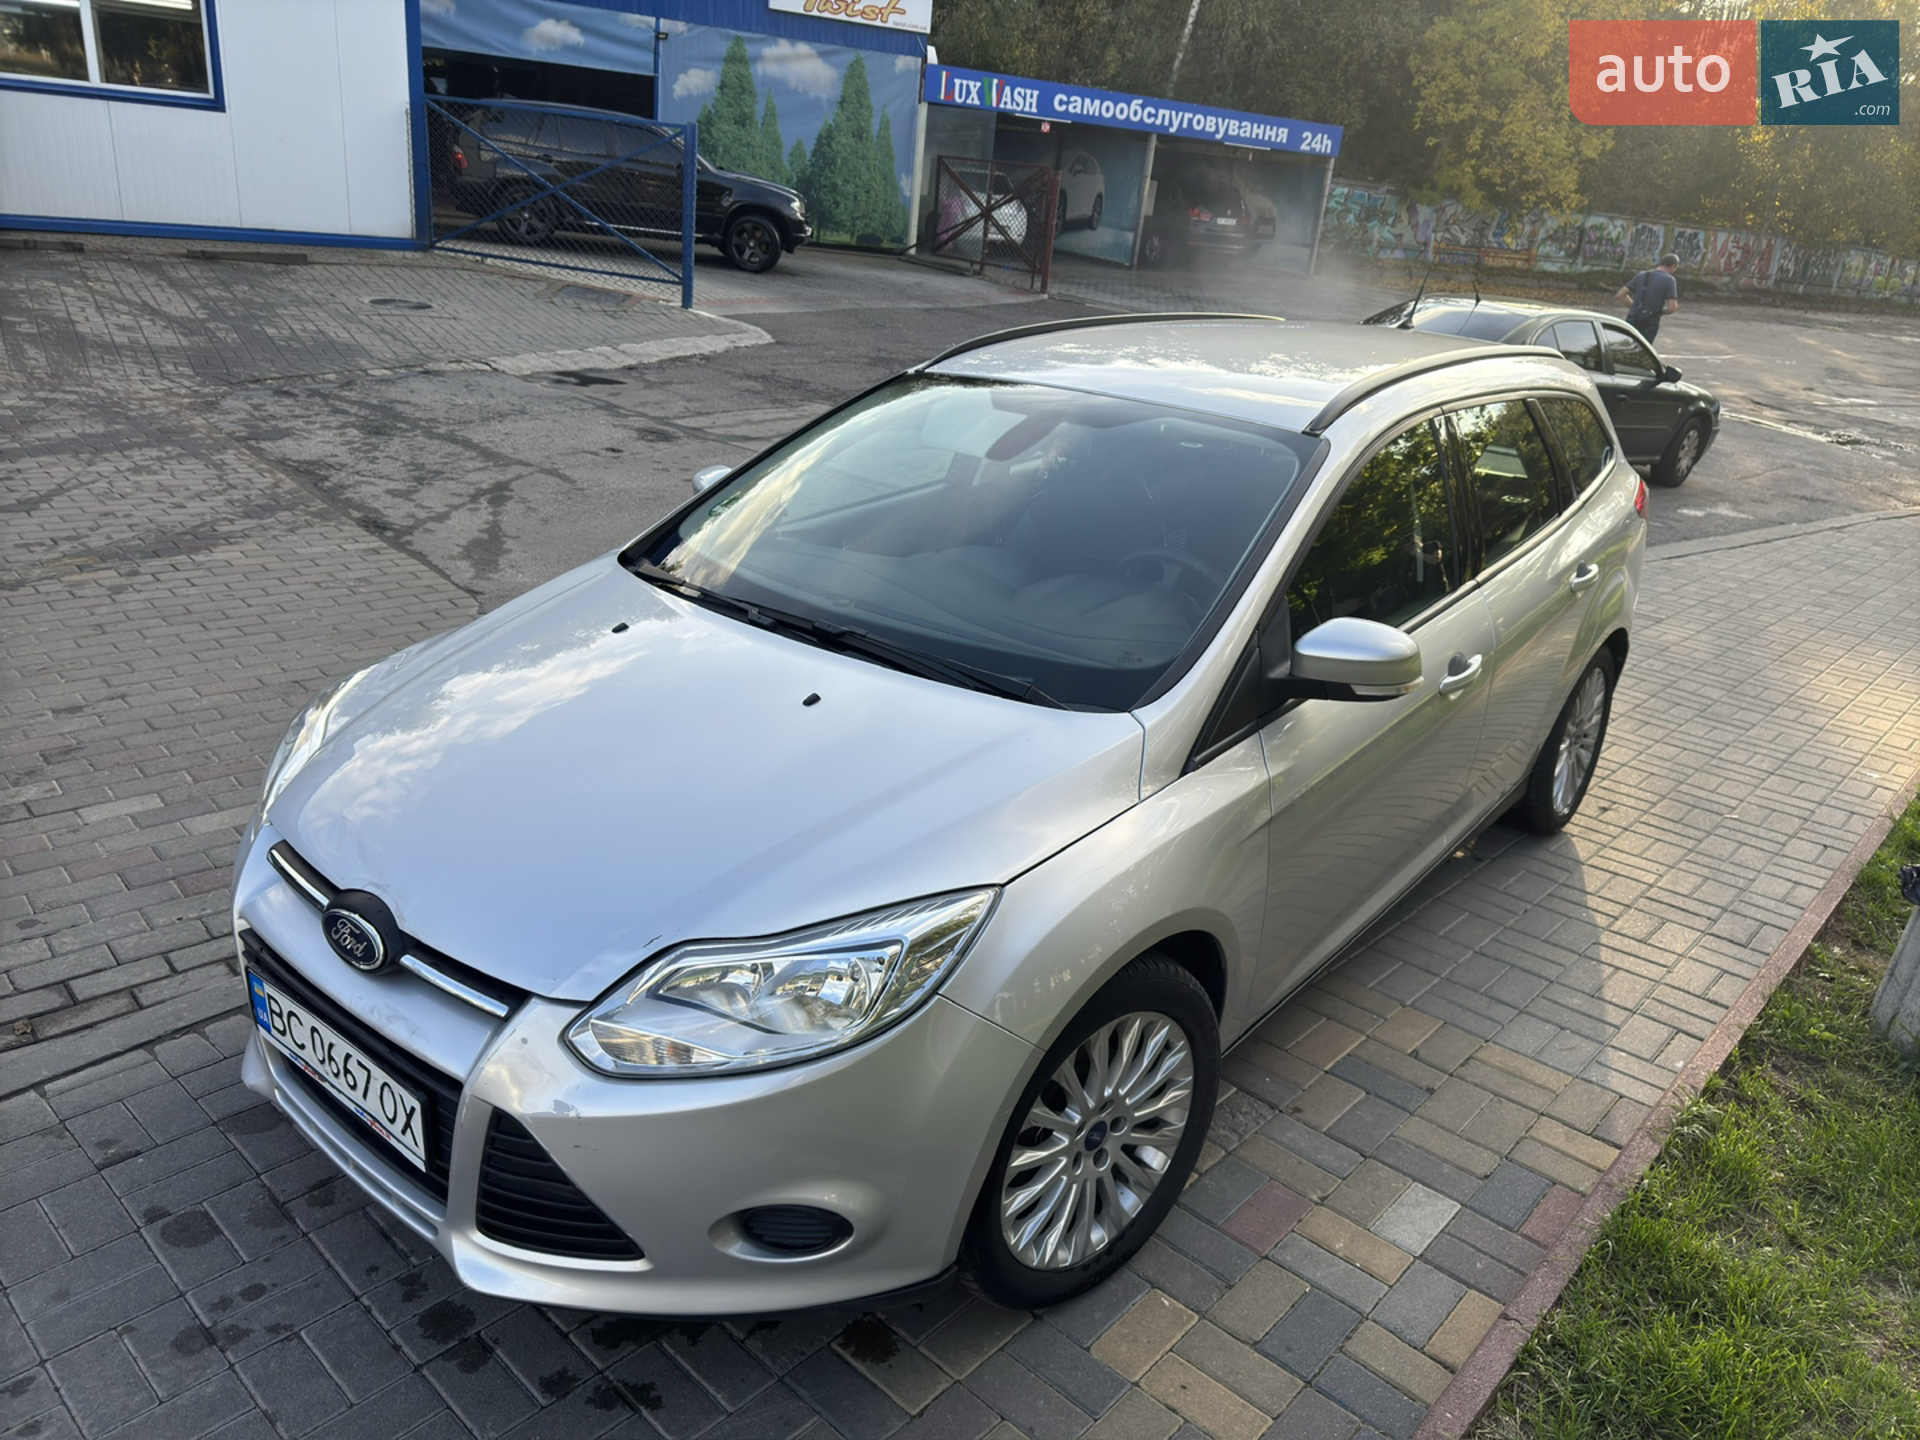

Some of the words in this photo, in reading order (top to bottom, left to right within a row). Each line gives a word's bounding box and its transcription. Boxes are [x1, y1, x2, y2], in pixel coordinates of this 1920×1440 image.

[1053, 93, 1289, 144] самообслуговування
[1300, 131, 1333, 153] 24h
[331, 918, 367, 957] Ford
[266, 991, 306, 1050] BC
[310, 1025, 371, 1100] 0667
[379, 1081, 420, 1149] OX
